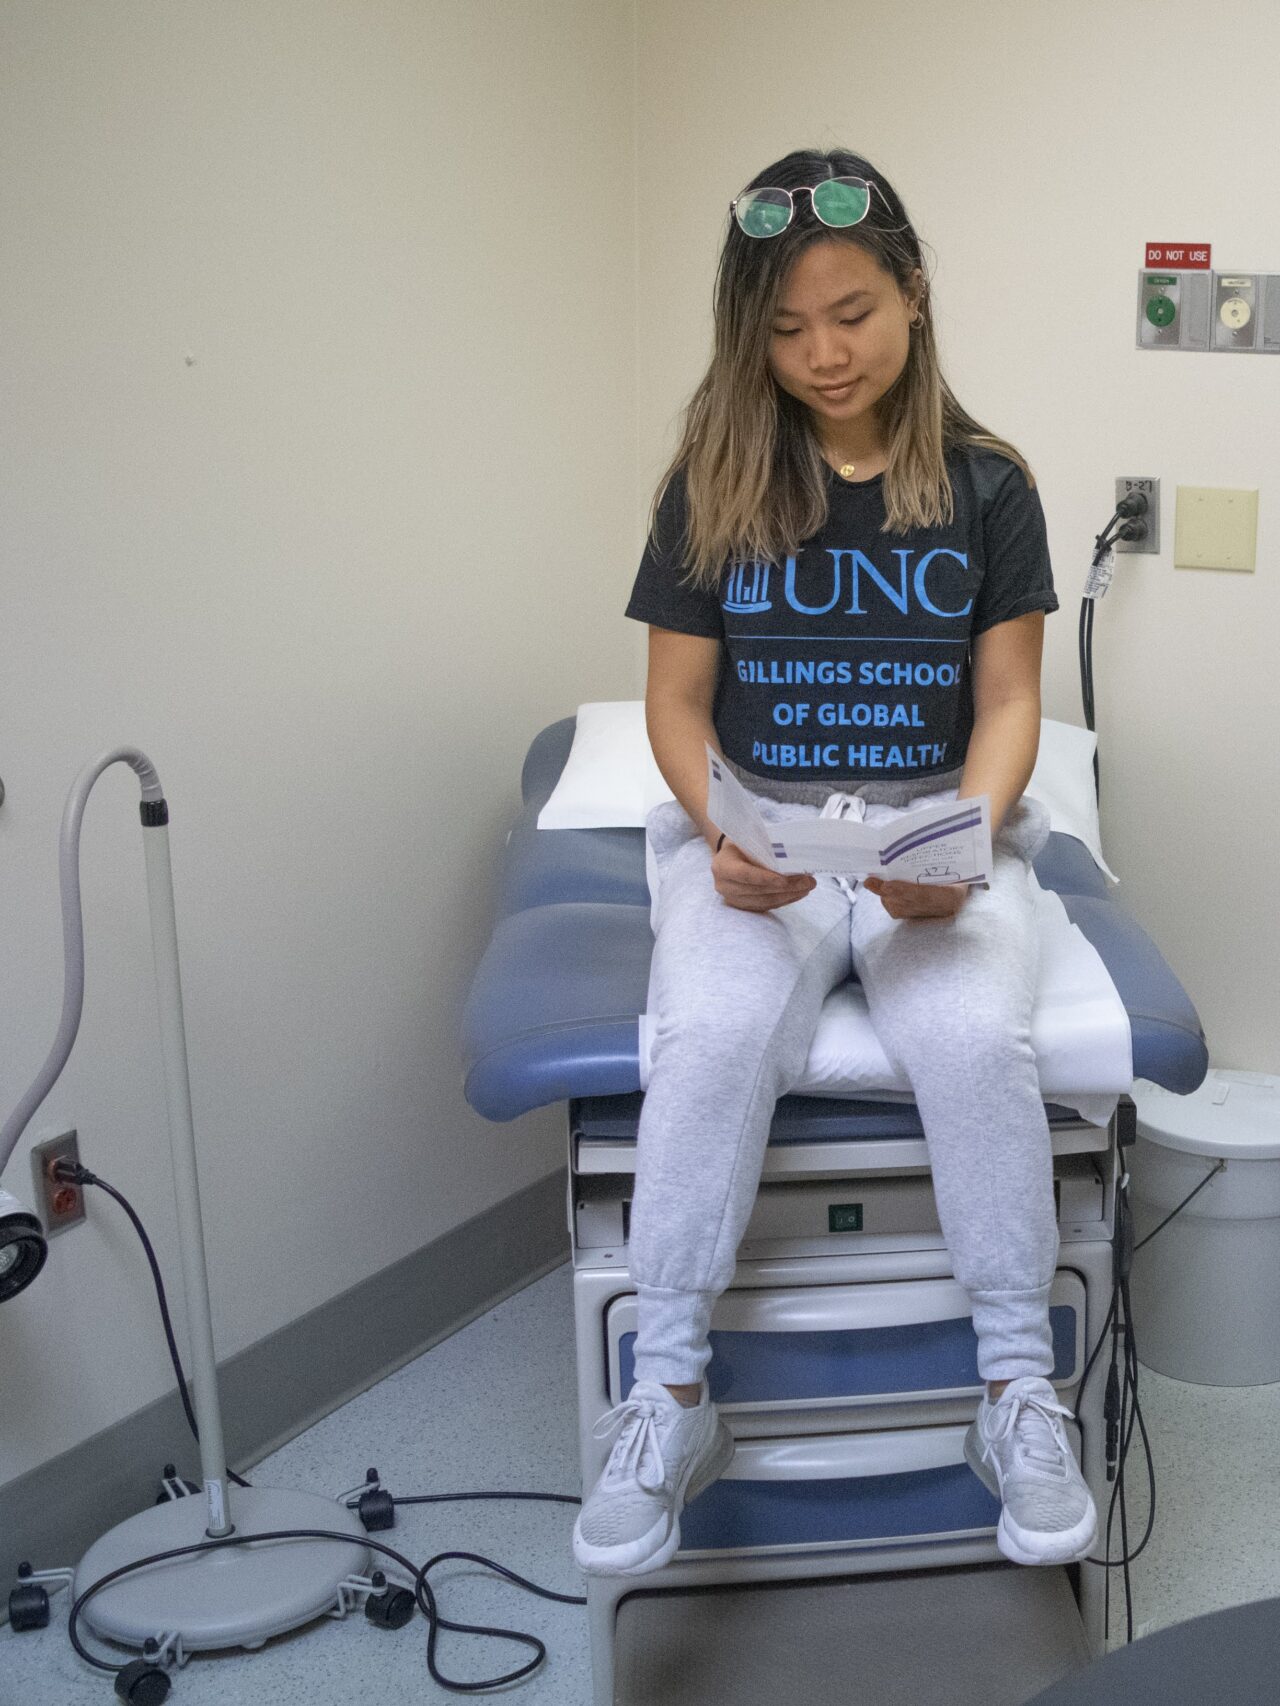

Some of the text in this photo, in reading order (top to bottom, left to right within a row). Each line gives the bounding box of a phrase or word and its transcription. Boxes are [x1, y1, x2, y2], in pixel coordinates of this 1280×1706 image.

[1148, 250, 1208, 261] DO NOT USE
[784, 548, 973, 617] UNC
[737, 660, 961, 687] GILLINGS SCHOOL
[773, 703, 925, 726] OF GLOBAL
[753, 740, 947, 768] PUBLIC HEALTH
